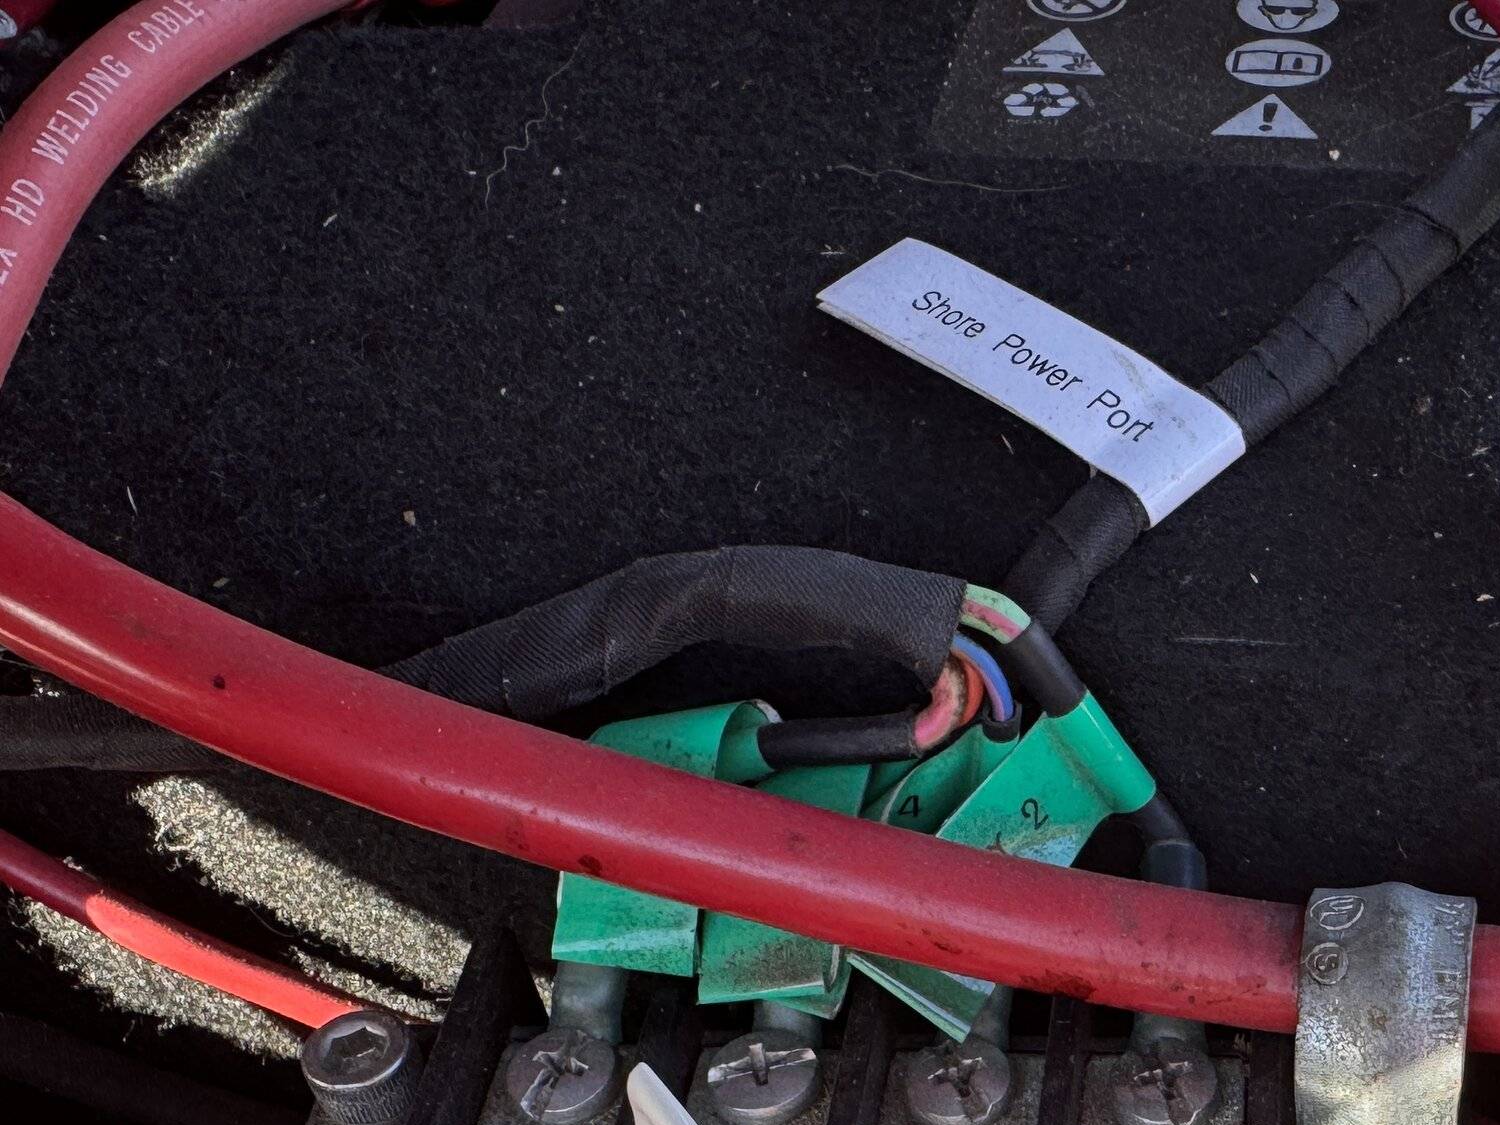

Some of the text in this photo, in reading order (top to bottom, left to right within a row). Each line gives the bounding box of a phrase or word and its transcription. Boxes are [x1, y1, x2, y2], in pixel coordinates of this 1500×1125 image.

[1, 178, 45, 225] HD
[31, 53, 131, 165] WELDING
[128, 0, 205, 53] CABLE
[911, 291, 1155, 443] Shore Power Port
[898, 795, 919, 817] 4
[1021, 798, 1049, 830] 2
